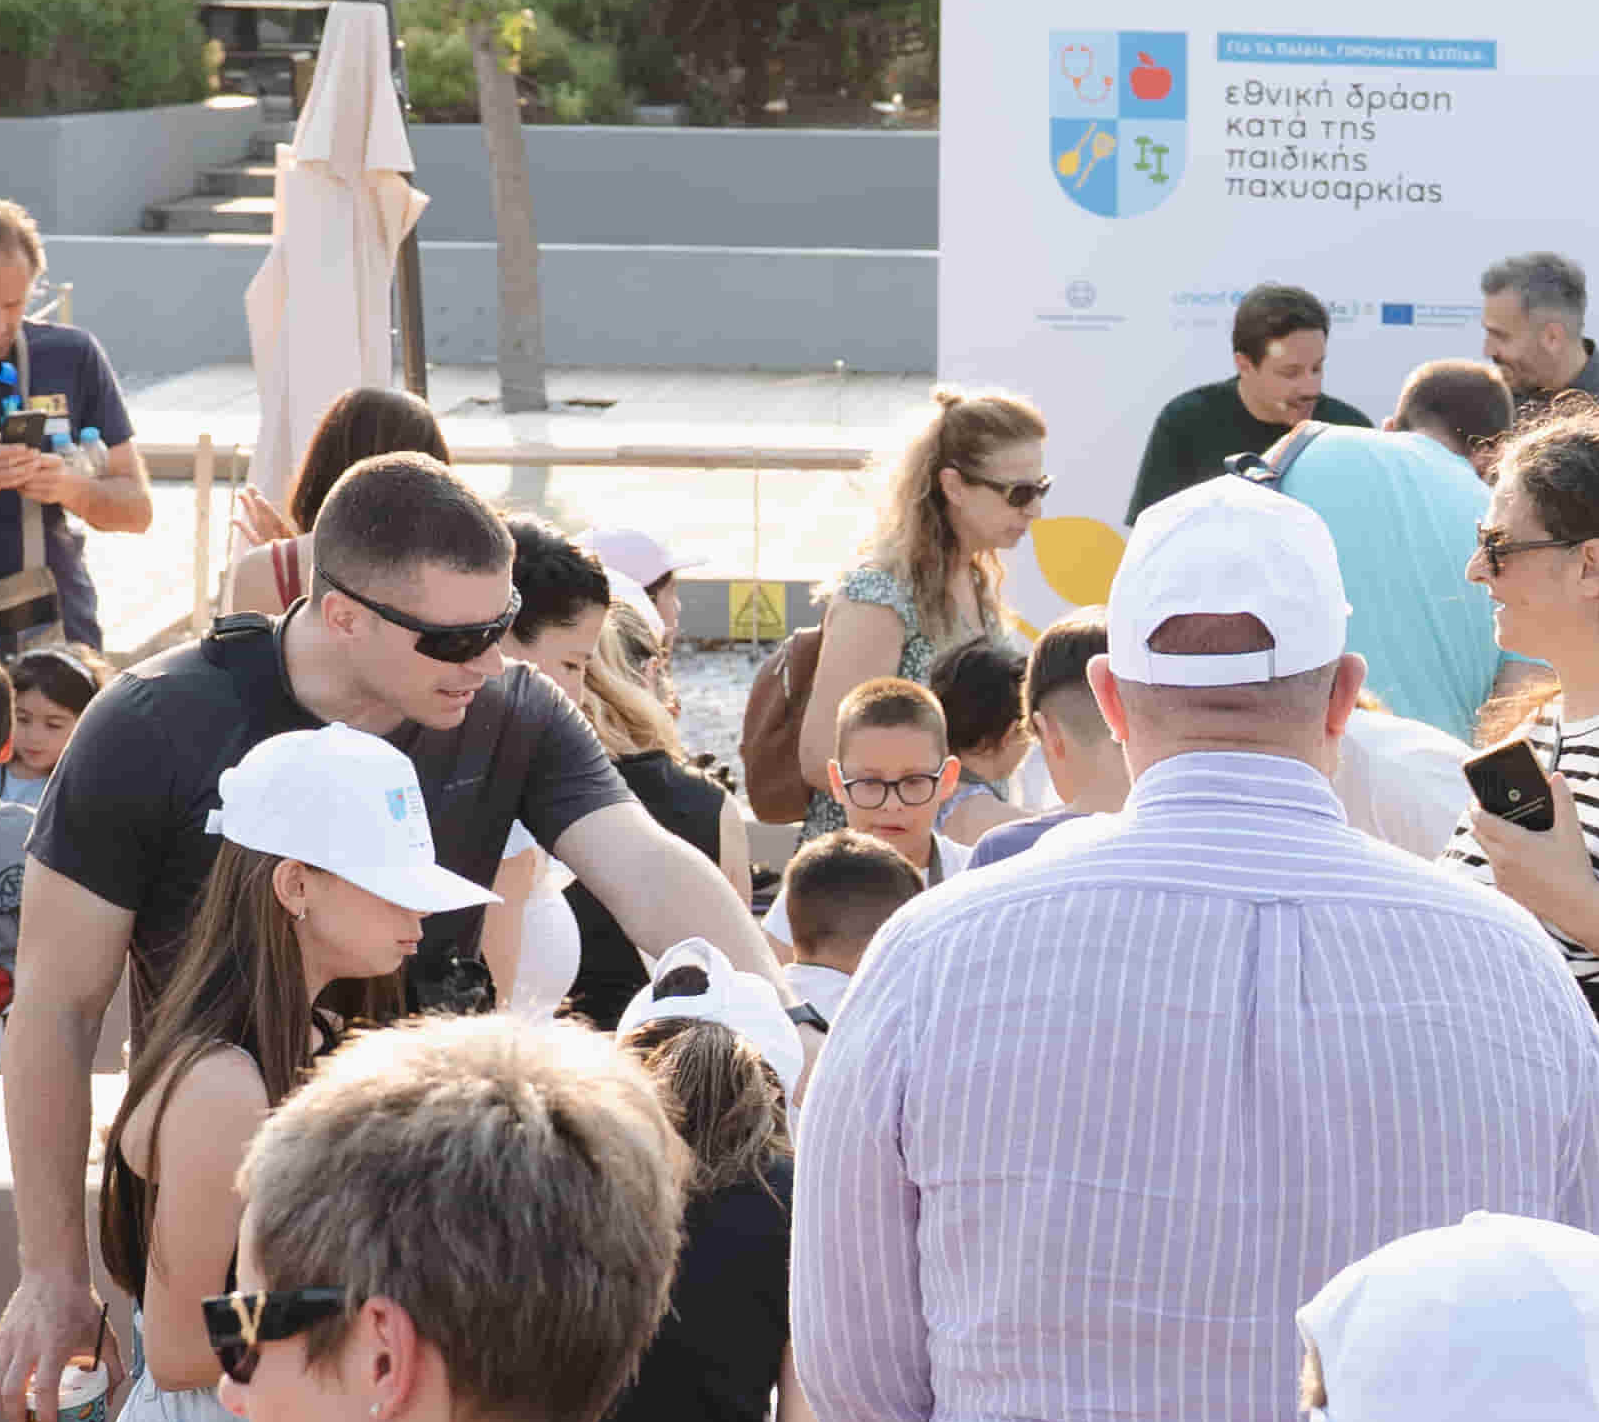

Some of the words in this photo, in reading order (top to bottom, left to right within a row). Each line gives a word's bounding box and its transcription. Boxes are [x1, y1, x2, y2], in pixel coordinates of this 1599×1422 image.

[1225, 78, 1334, 108] εθνική
[1346, 82, 1453, 118] δράση
[1225, 111, 1307, 139] κατά
[1320, 120, 1377, 142] της
[1225, 143, 1369, 173] παιδικής
[1225, 173, 1443, 211] παχυσαρκίας
